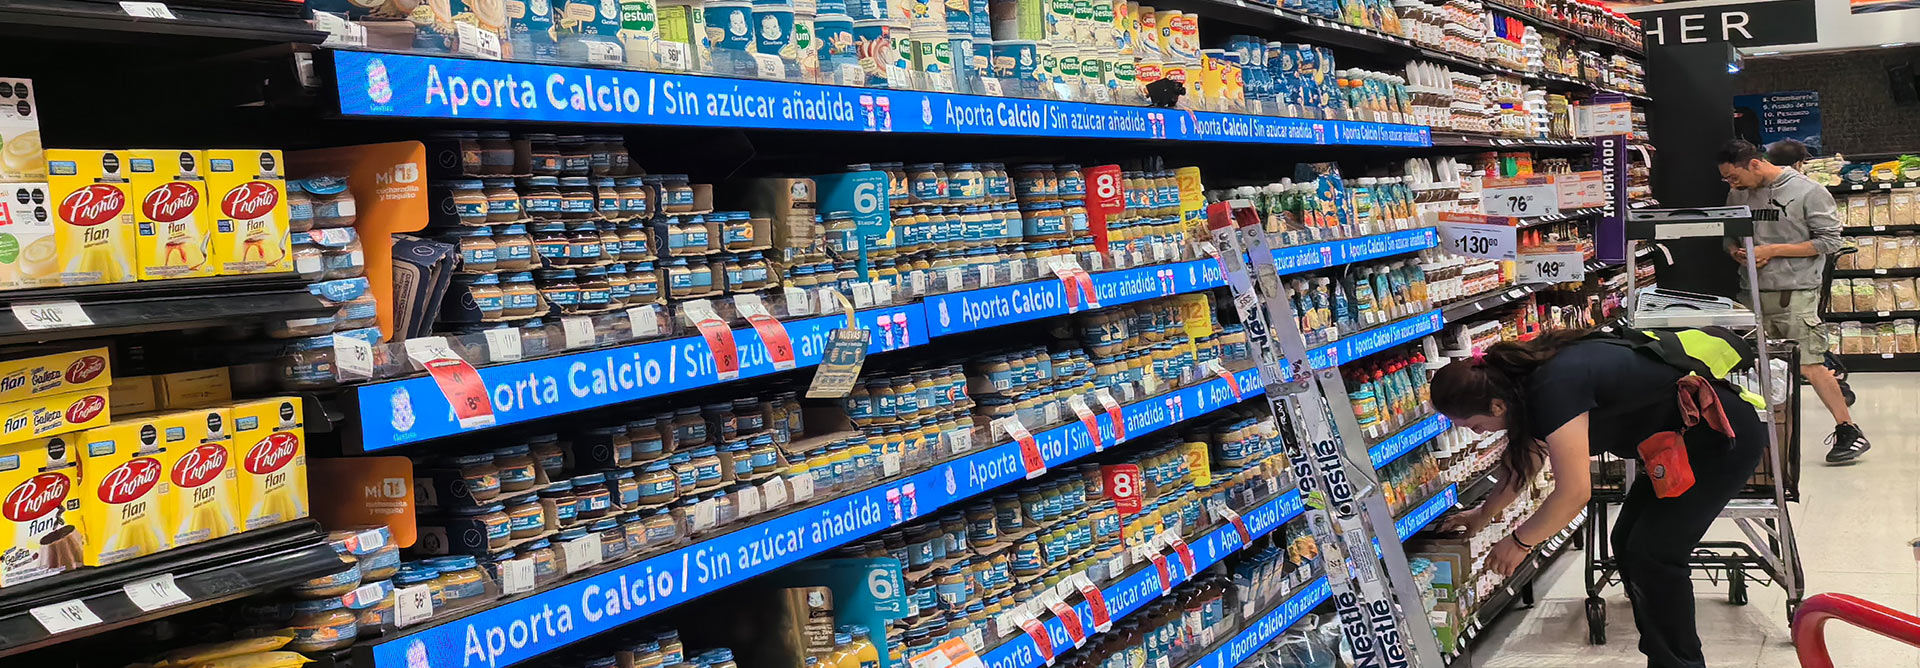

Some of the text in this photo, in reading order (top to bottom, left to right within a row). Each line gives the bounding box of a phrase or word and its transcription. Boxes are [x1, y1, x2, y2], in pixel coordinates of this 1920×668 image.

[425, 64, 537, 116] Aporta
[545, 73, 640, 113] Calcio
[663, 79, 699, 117] Sin
[706, 85, 775, 120] azúcar
[782, 89, 855, 122] añadida
[945, 99, 993, 131] Aporta
[997, 102, 1040, 128] Calcio
[1050, 108, 1068, 130] Sin
[1071, 109, 1105, 131] azúcar
[1108, 112, 1146, 133] añadida
[1222, 117, 1248, 137] Calcio
[1253, 119, 1265, 137] Sin
[1266, 120, 1287, 138] azúcar
[1289, 121, 1313, 139] añadida
[1343, 124, 1360, 143] Aporta
[1361, 124, 1377, 140] Calcio
[376, 168, 393, 185] Mi
[1096, 174, 1115, 198] 8
[1602, 139, 1615, 218] IMPORTADO
[63, 184, 119, 222] Pronto
[144, 183, 196, 219] Pronto
[222, 182, 276, 218] Pronto
[853, 182, 877, 214] 6
[84, 226, 109, 243] flan
[168, 222, 185, 234] flan
[246, 219, 264, 232] flan
[875, 216, 883, 226] 2
[1297, 246, 1320, 266] añadida
[1350, 243, 1367, 260] Aporta
[1368, 238, 1385, 255] Calcio
[962, 294, 1009, 328] Aporta
[1012, 285, 1054, 314] Calcio
[1119, 270, 1156, 297] añadida
[1355, 338, 1374, 356] Aporta
[1373, 331, 1390, 350] Calcio
[1, 375, 25, 393] flan
[66, 359, 102, 382] Pronto
[568, 352, 661, 398] Calcio
[4, 416, 27, 434] flan
[66, 399, 102, 422] Pronto
[246, 435, 295, 473] Pronto
[969, 452, 1017, 490] Aporta
[1070, 425, 1089, 451] Sin
[1127, 401, 1164, 432] añadida
[1382, 440, 1398, 460] Calcio
[173, 447, 223, 486] Pronto
[265, 471, 286, 489] flan
[101, 461, 156, 502] Pronto
[193, 485, 215, 503] flan
[365, 482, 381, 498] Mi
[1113, 473, 1132, 498] 8
[6, 479, 63, 519] Pronto
[122, 501, 147, 520] flan
[1131, 500, 1138, 508] 3
[29, 518, 55, 537] flan
[1249, 507, 1275, 534] Calcio
[1280, 498, 1291, 518] Sin
[464, 603, 573, 668] Aporta
[582, 566, 673, 623] Calcio
[696, 546, 731, 584] Sin
[738, 528, 805, 577] azúcar
[812, 495, 881, 544] añadida
[868, 568, 893, 599] 6
[890, 569, 900, 597] meses
[892, 602, 900, 613] 2
[1230, 631, 1258, 664] Aporta
[1258, 613, 1284, 641] Calcio
[1288, 600, 1299, 620] Sin
[1300, 588, 1320, 612] azúcar
